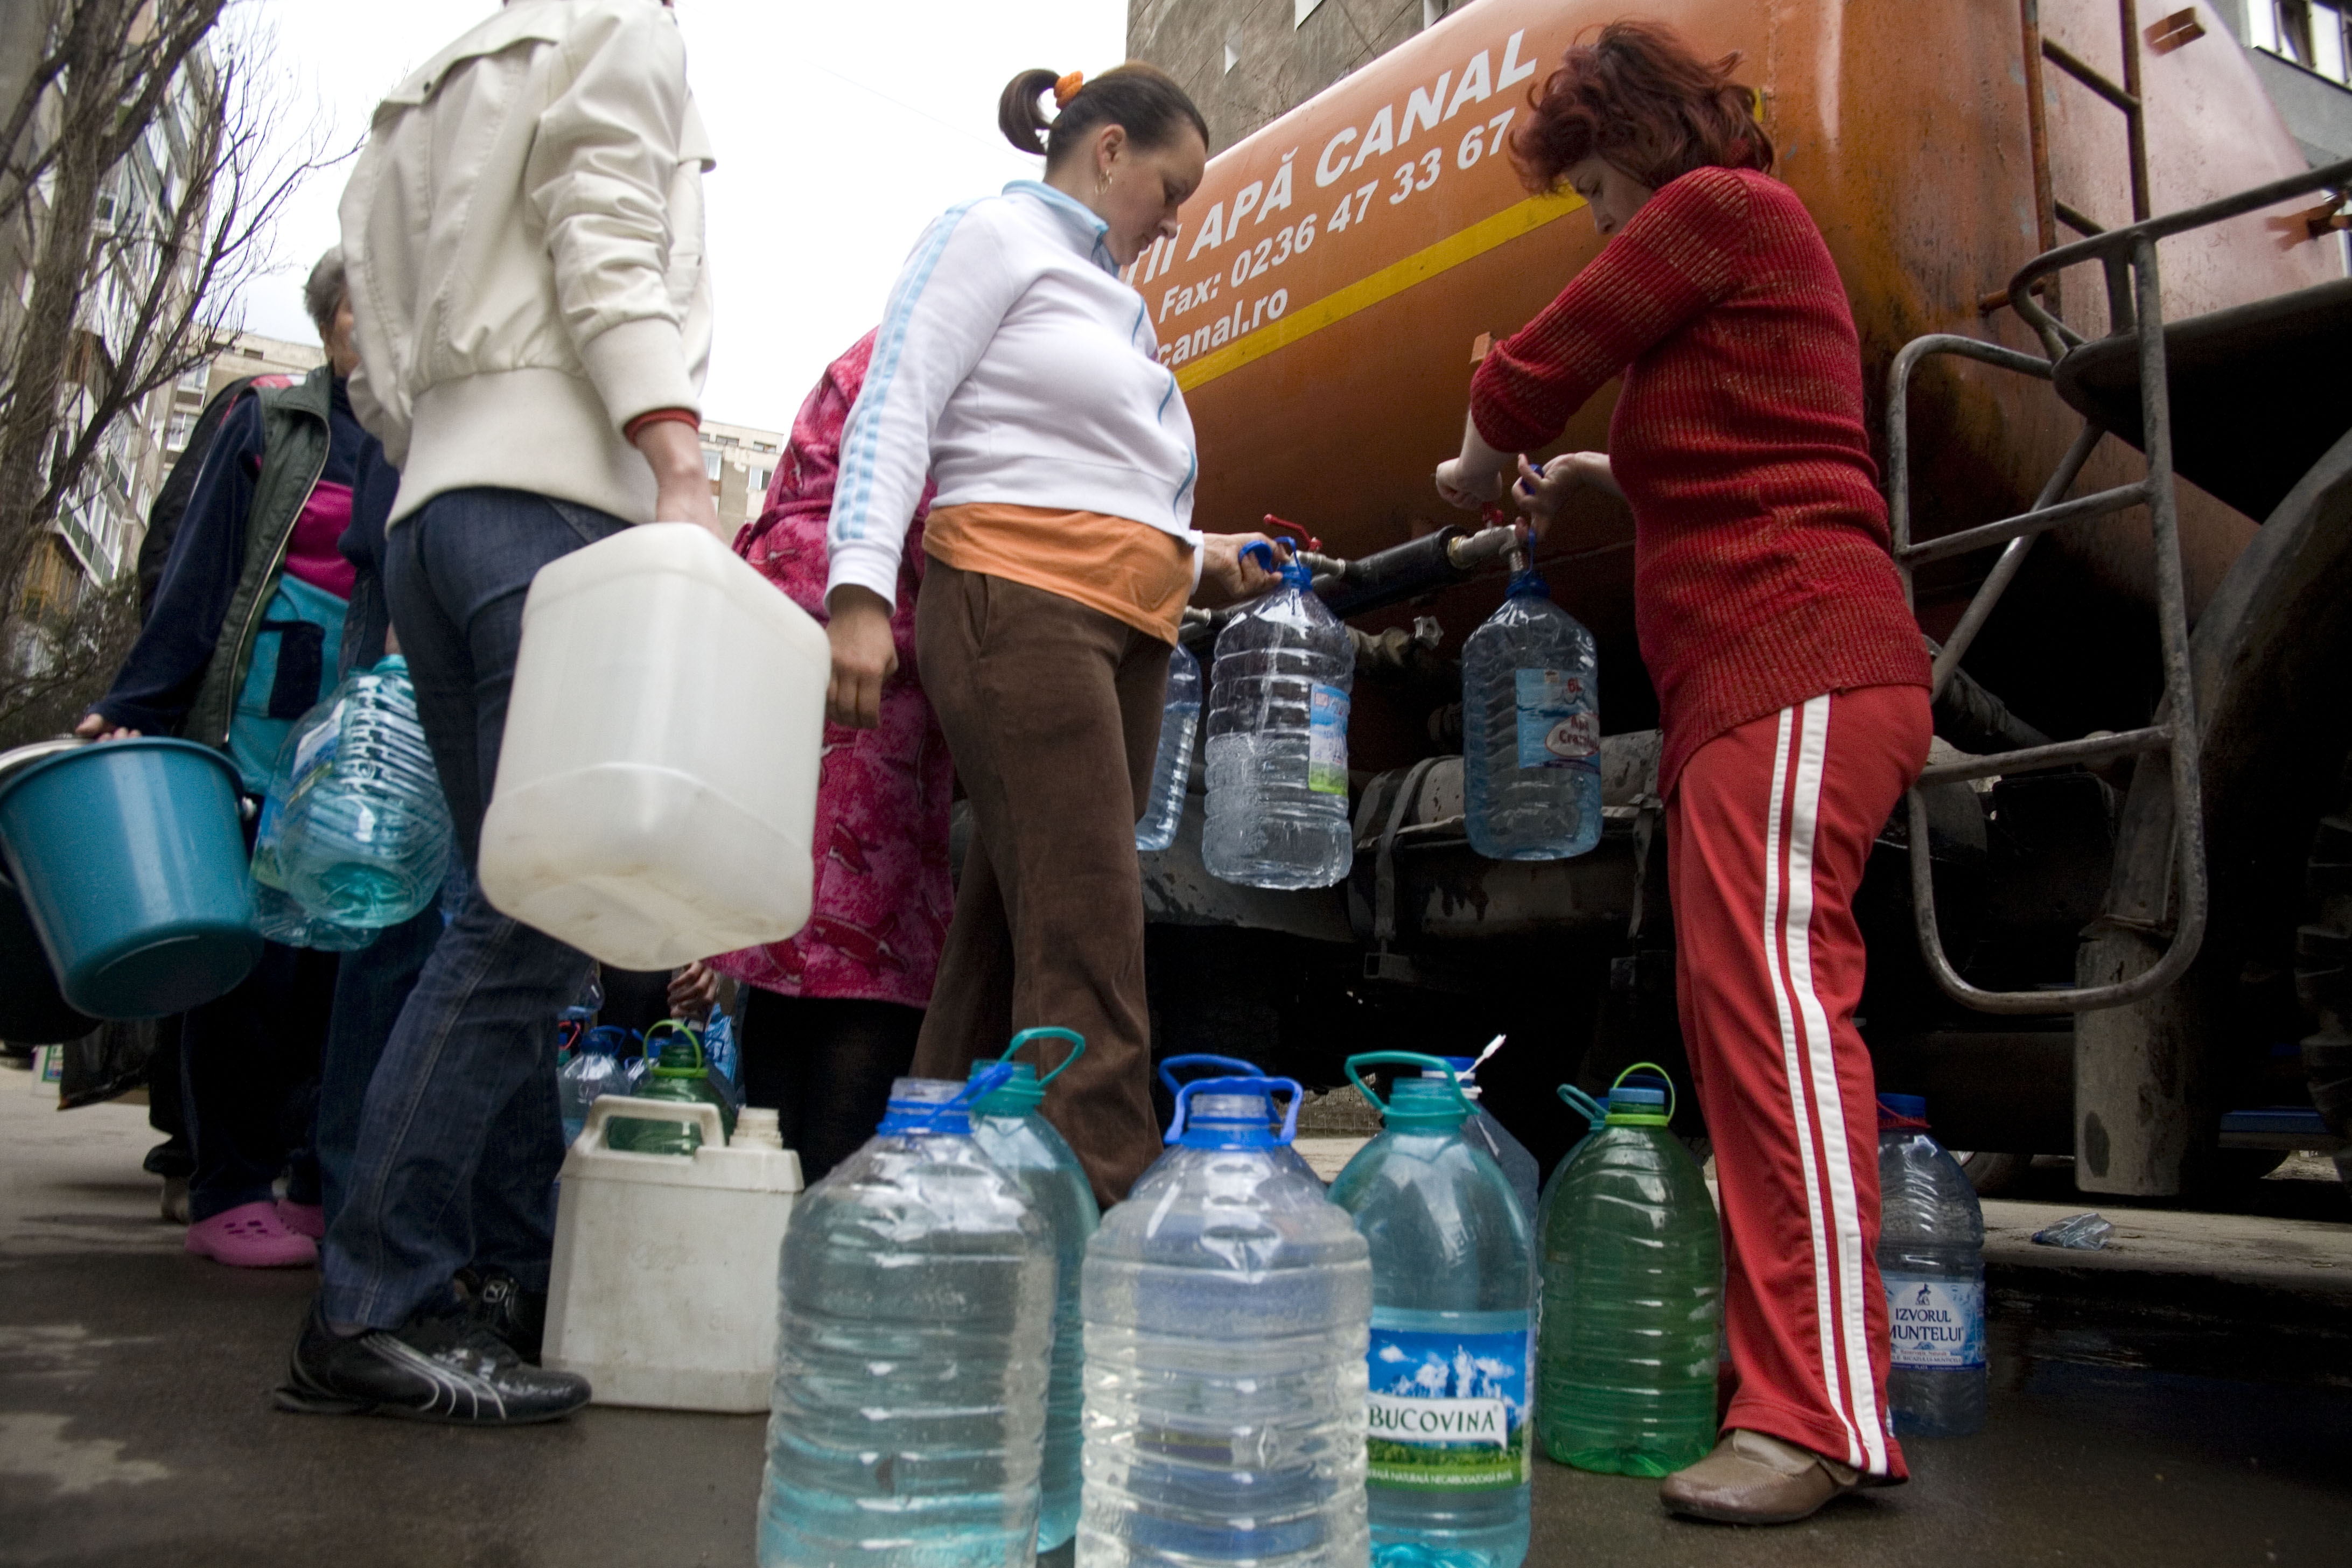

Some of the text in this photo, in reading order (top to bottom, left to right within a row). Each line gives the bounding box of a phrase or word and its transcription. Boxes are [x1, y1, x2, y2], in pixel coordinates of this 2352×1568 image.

[1186, 146, 1299, 262] APĂ
[1314, 28, 1537, 187] CANAL
[1159, 107, 1516, 324] Fax: 0236 47 33 67
[1895, 1308, 1951, 1322] IZVORUL
[1369, 1404, 1495, 1432] BUCOVINA
